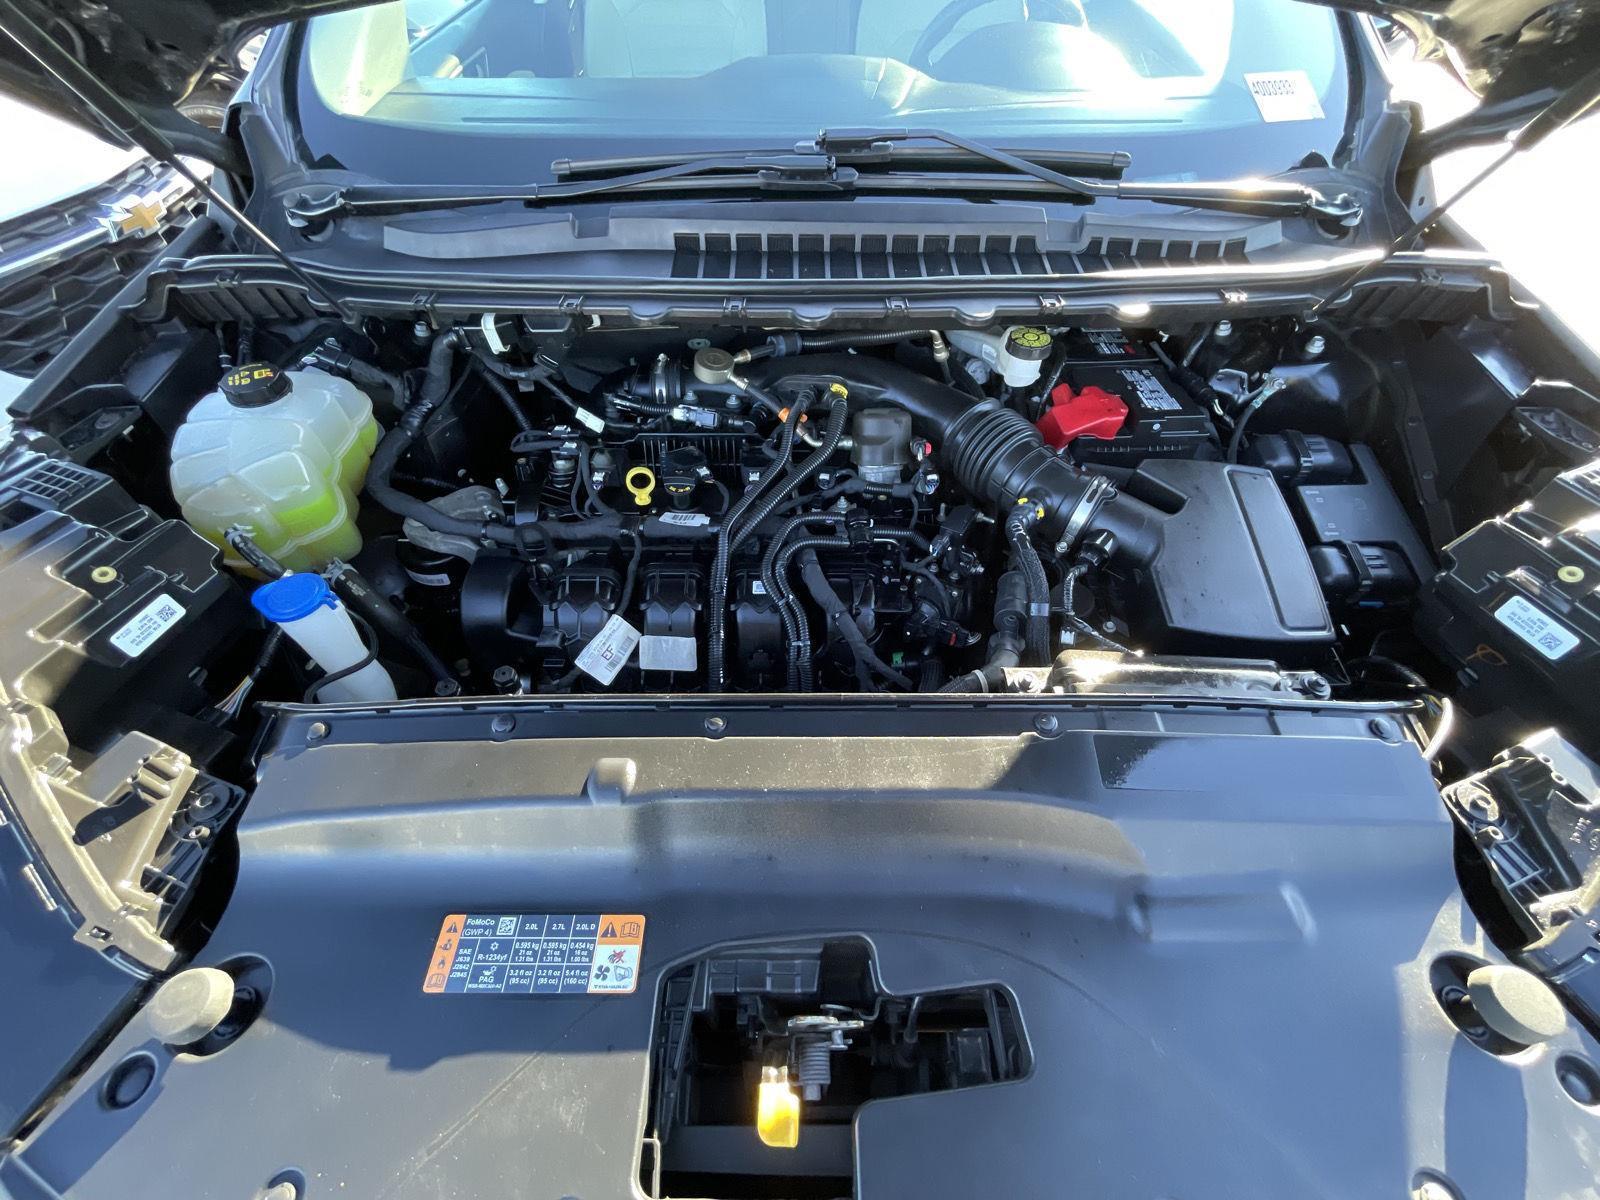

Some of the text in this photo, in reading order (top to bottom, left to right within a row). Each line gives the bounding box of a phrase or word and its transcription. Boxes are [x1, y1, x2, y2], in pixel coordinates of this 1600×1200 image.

[466, 918, 495, 926] FoMoCo
[461, 928, 493, 937] (GWP 4)
[531, 942, 540, 950] kg
[559, 942, 567, 950] kg
[586, 942, 595, 950] kg
[477, 954, 507, 962] R-1234yf
[509, 977, 530, 985] (95 cc)
[537, 977, 558, 985] (95 cc)
[563, 977, 588, 985] (160 cc)
